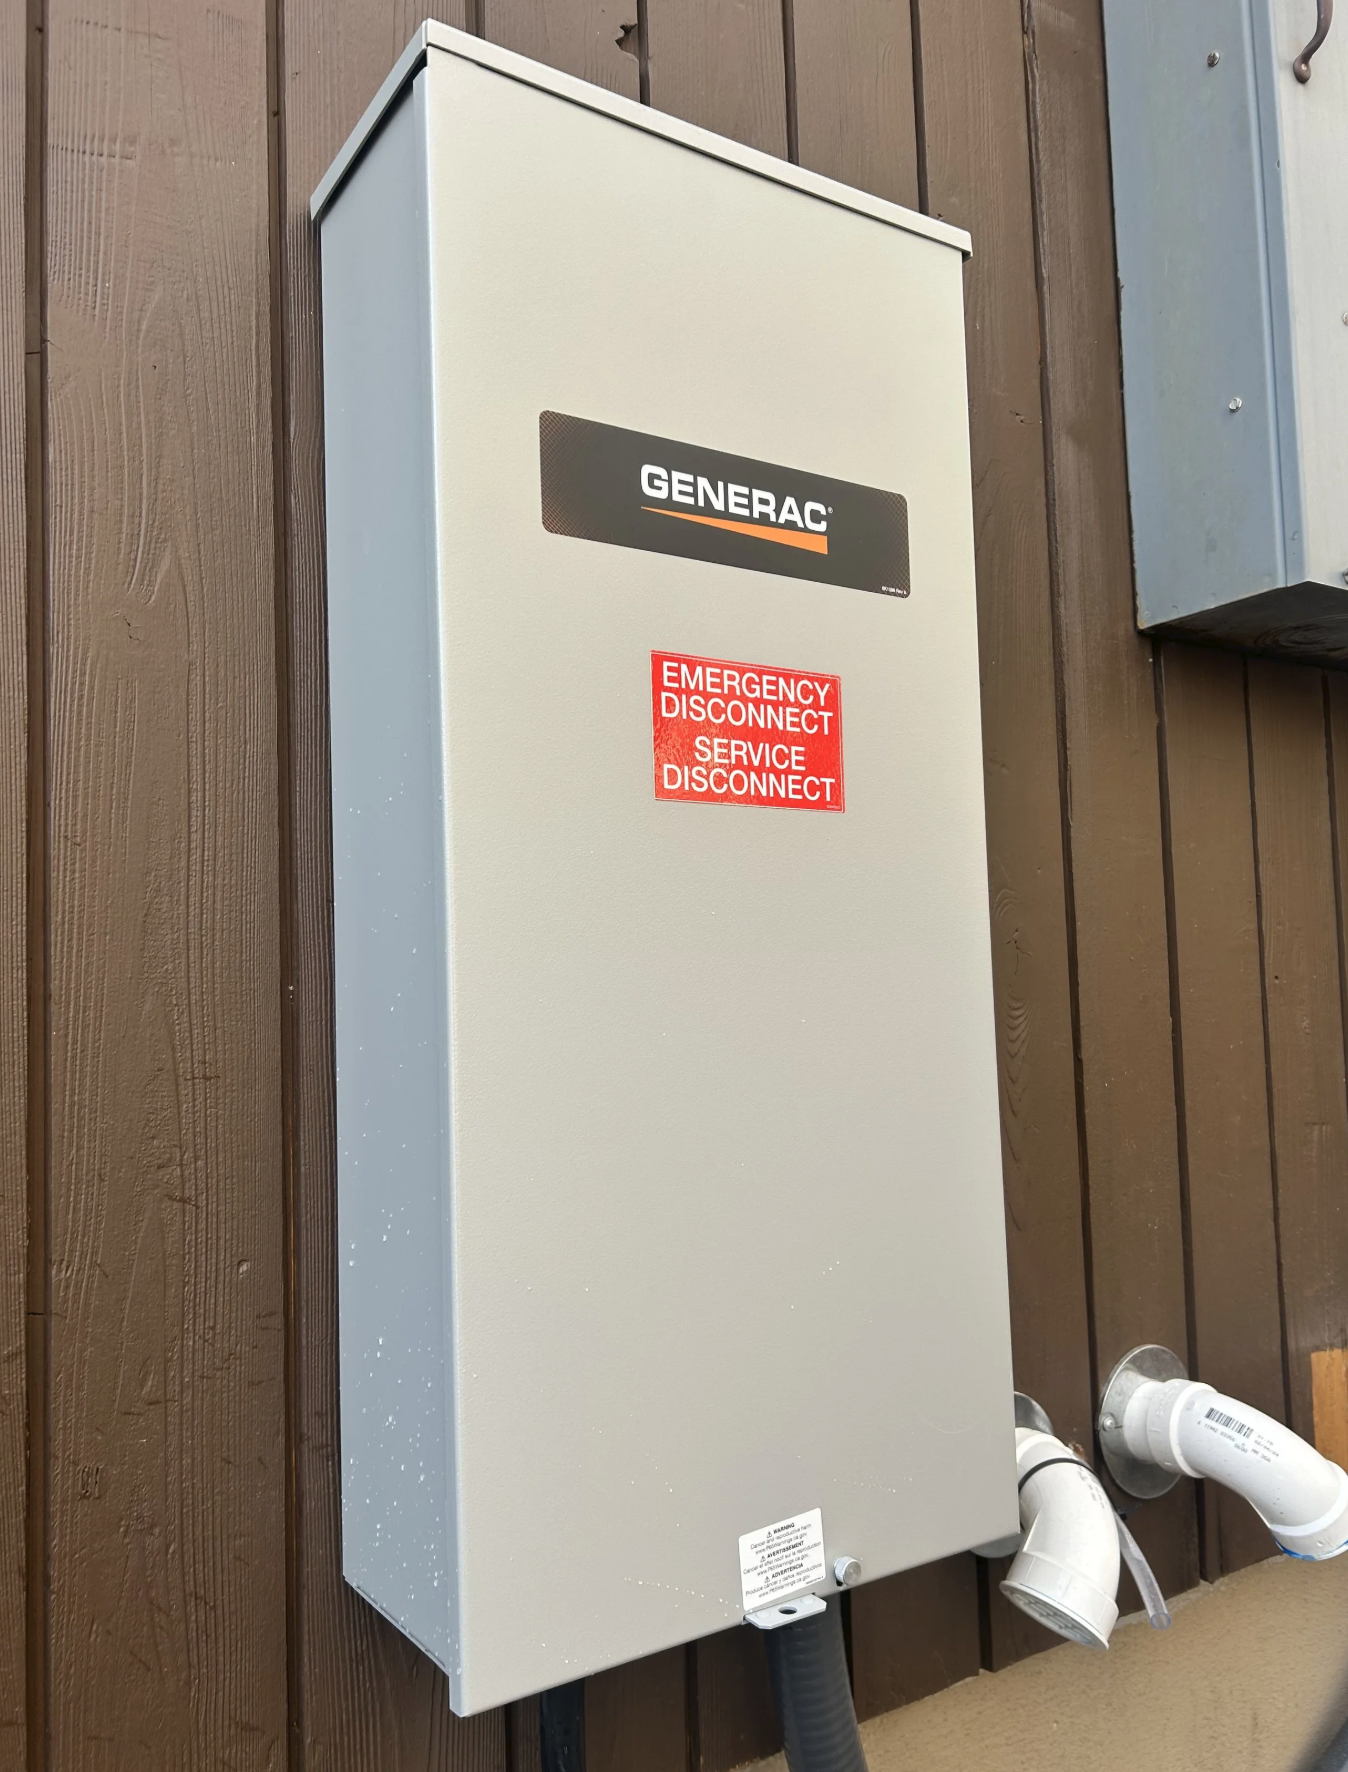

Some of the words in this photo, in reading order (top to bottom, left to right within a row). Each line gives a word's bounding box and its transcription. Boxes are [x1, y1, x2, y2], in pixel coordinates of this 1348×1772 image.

[662, 661, 830, 707] EMERGENCY
[660, 691, 834, 735] DISCONNECT
[694, 735, 806, 771] SERVICE
[662, 764, 836, 802] DISCONNECT
[750, 1540, 765, 1550] Cancer
[776, 1528, 800, 1541] reproductive
[801, 1523, 812, 1531] harm
[773, 1522, 795, 1534] WARNING
[743, 1565, 758, 1575] Cancer
[796, 1541, 822, 1555] reproduction
[767, 1540, 804, 1558] AVERTISSEMENT
[746, 1586, 763, 1596] Produce
[796, 1562, 822, 1576] reproductivos
[772, 1562, 804, 1579] ADVERTENCIA
